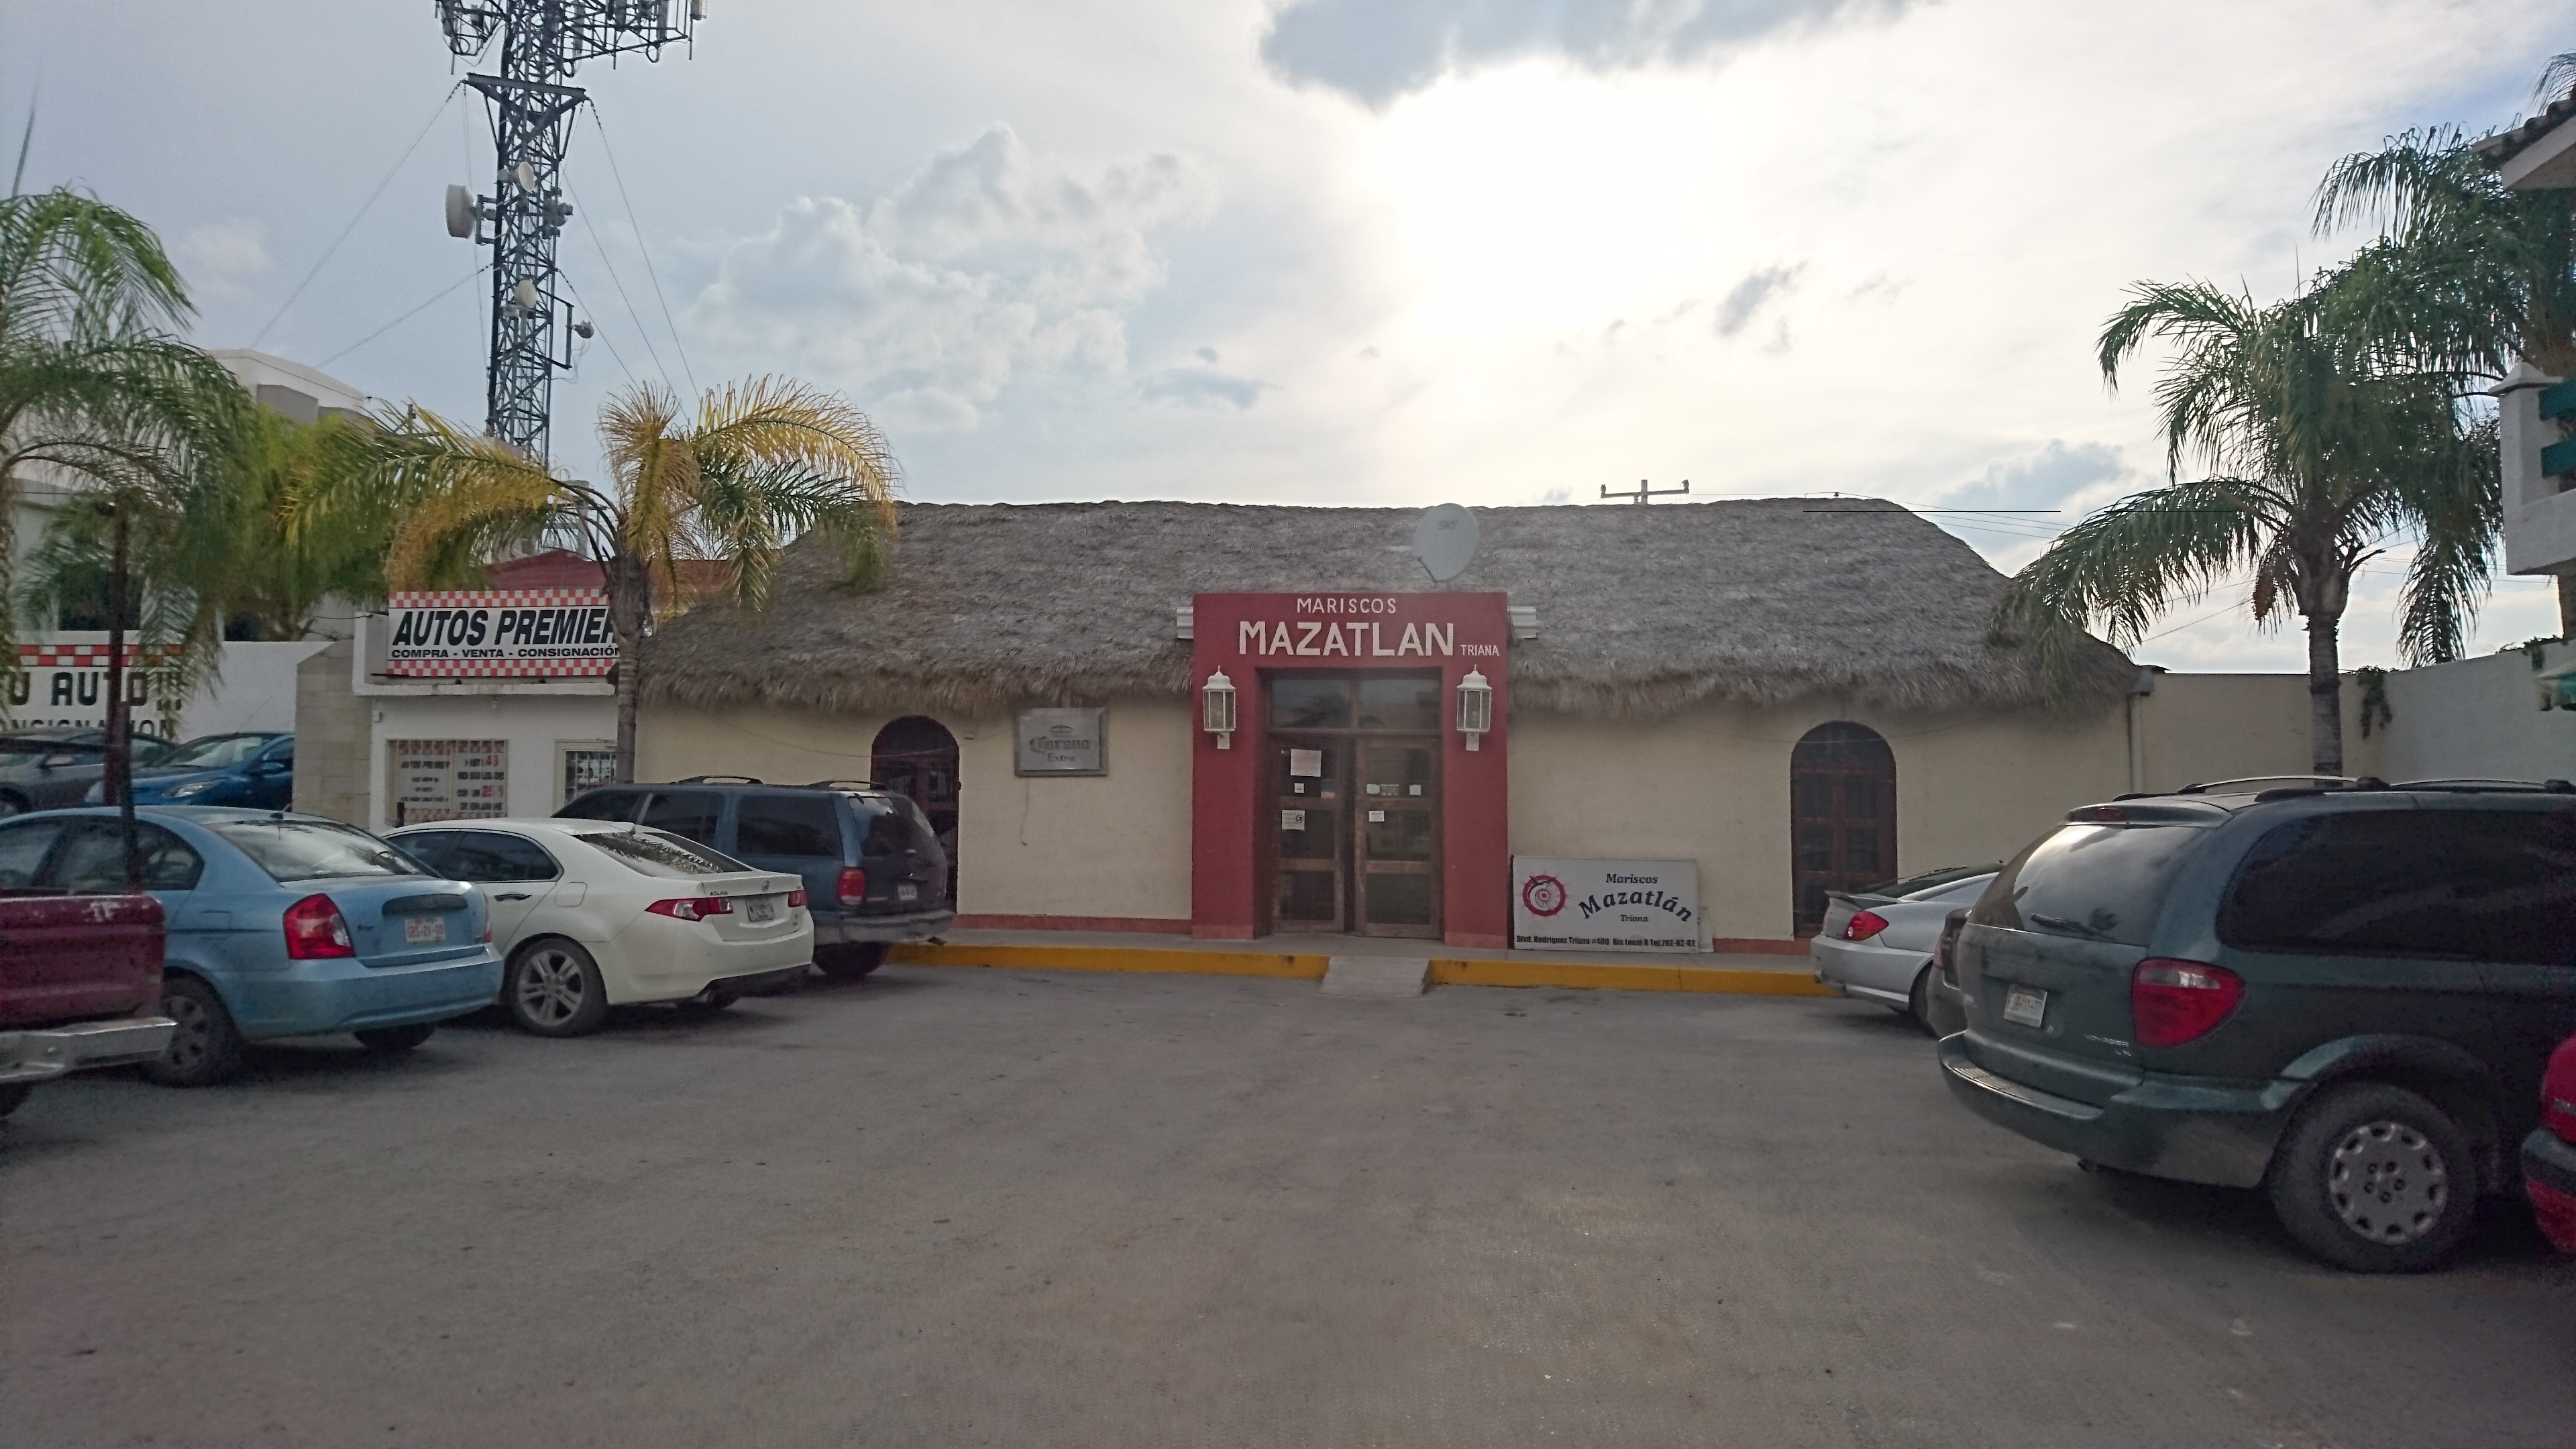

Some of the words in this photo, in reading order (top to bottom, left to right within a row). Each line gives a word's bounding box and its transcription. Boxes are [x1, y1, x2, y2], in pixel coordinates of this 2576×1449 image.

[1297, 598, 1397, 614] MARISCOS
[392, 609, 488, 646] AUTOS
[1238, 621, 1454, 657] MAZATLAN
[1460, 644, 1500, 657] TRIANA
[392, 649, 449, 658] COMPRA
[462, 649, 504, 657] VENTA
[1029, 737, 1090, 753] Corona
[1047, 753, 1076, 762] Extra
[1606, 873, 1658, 884] Mariscos
[1578, 891, 1692, 922] Mazatlán
